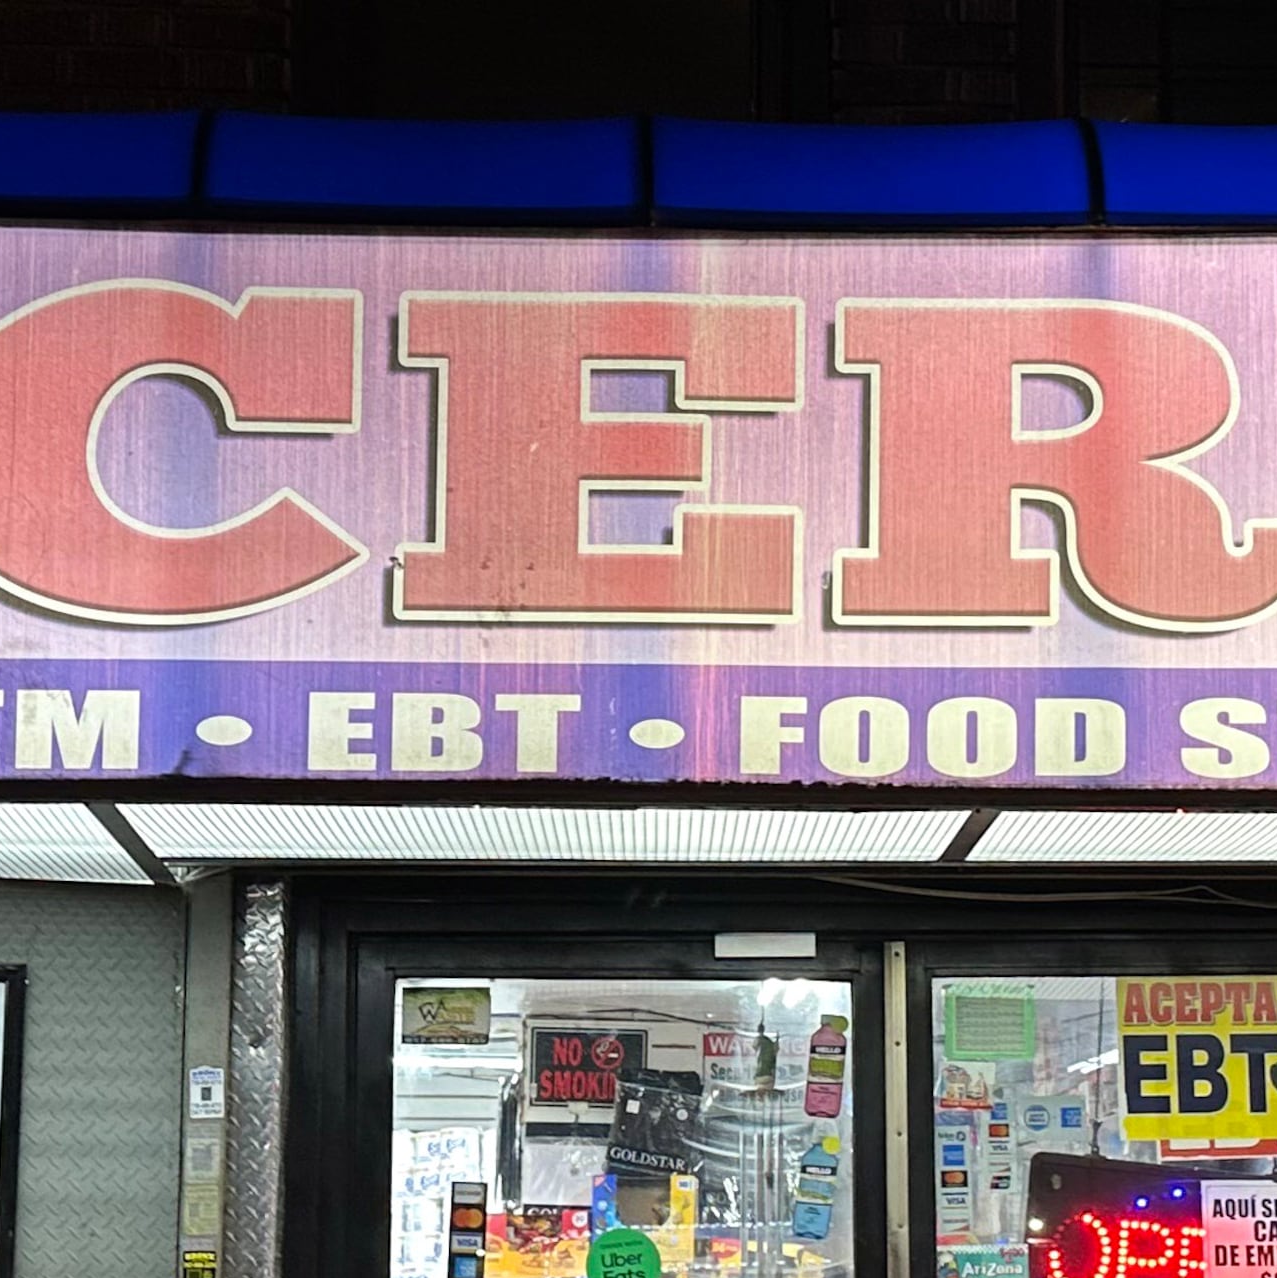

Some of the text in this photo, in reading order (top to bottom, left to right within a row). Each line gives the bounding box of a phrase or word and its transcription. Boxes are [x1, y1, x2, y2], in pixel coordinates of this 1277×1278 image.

[307, 692, 582, 774] EBT
[739, 696, 1127, 778] FOOD
[552, 1037, 583, 1066] NO
[538, 1069, 618, 1100] SMOKI
[609, 1146, 686, 1172] GOLDSTAR
[1213, 1194, 1257, 1220] AQUÍ
[600, 1252, 643, 1269] Uber
[1214, 1244, 1240, 1267] DE
[961, 1261, 1023, 1278] AriZona
